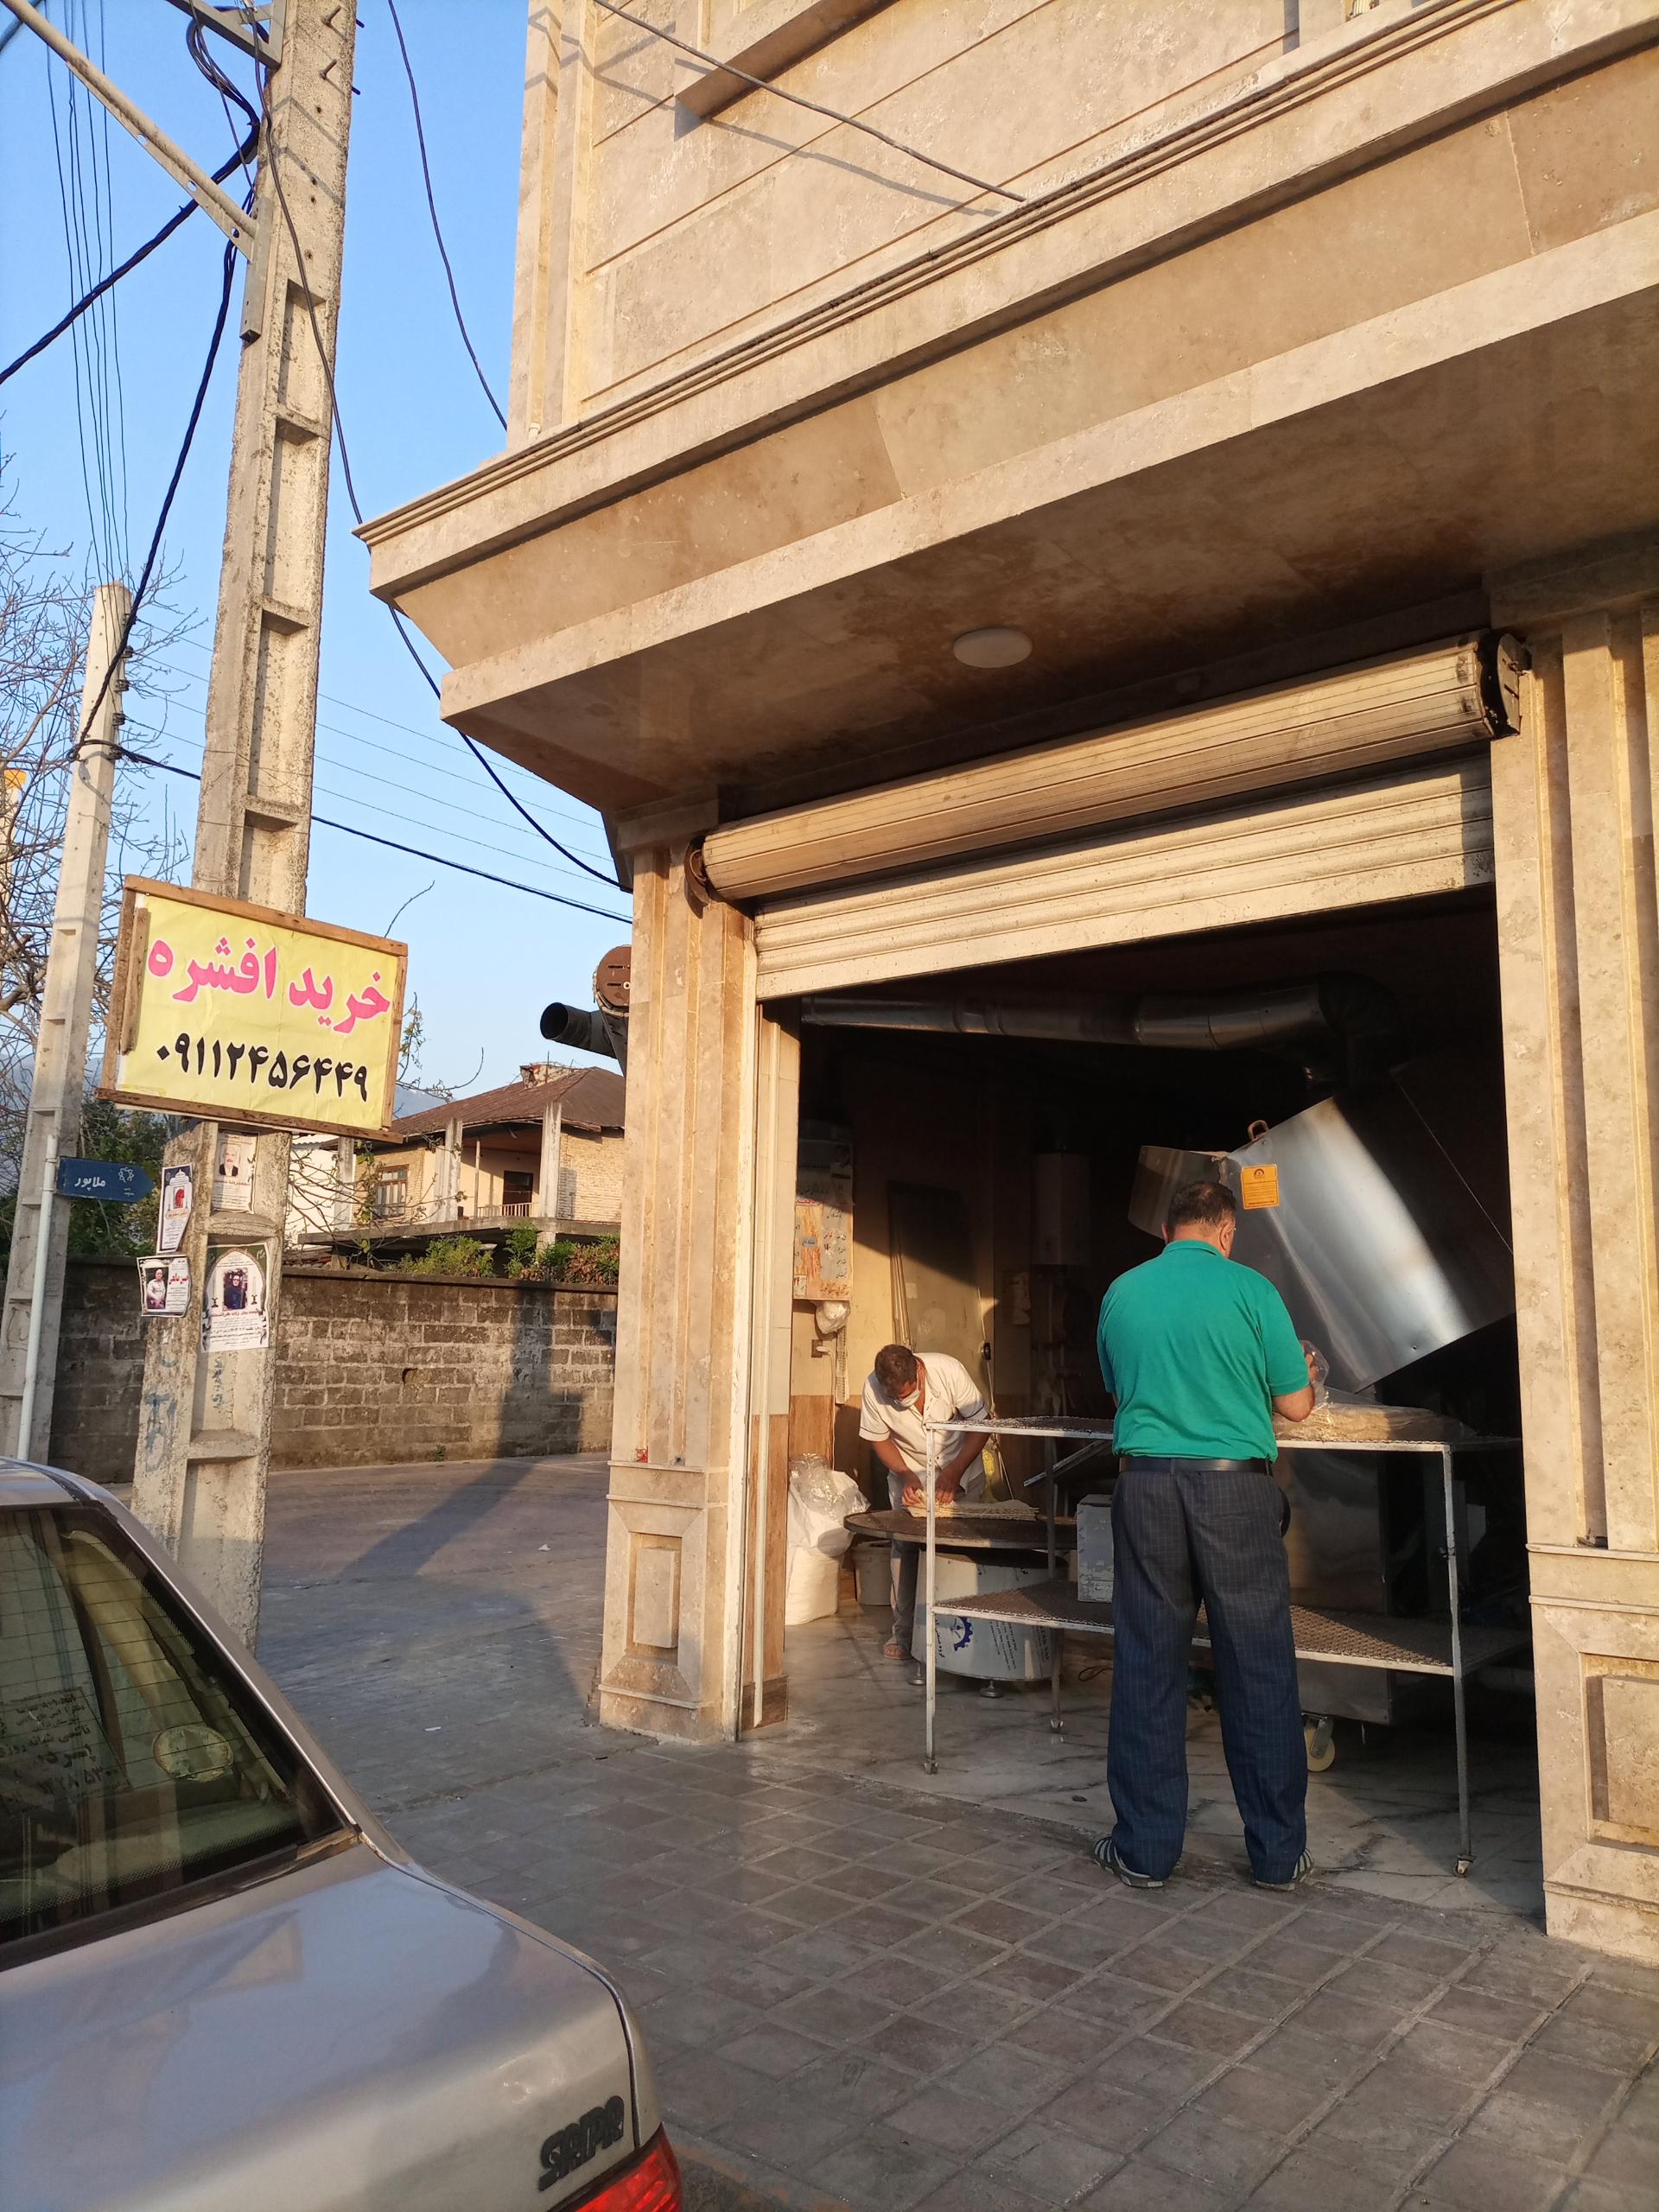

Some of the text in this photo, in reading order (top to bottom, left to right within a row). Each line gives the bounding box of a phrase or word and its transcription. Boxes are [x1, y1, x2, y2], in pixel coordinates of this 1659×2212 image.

[148, 937, 391, 1033] خرید افشره
[156, 1033, 368, 1103] ۰۹۱۱۲۴۵۶۴۴۹
[74, 1176, 106, 1192] ملاپور
